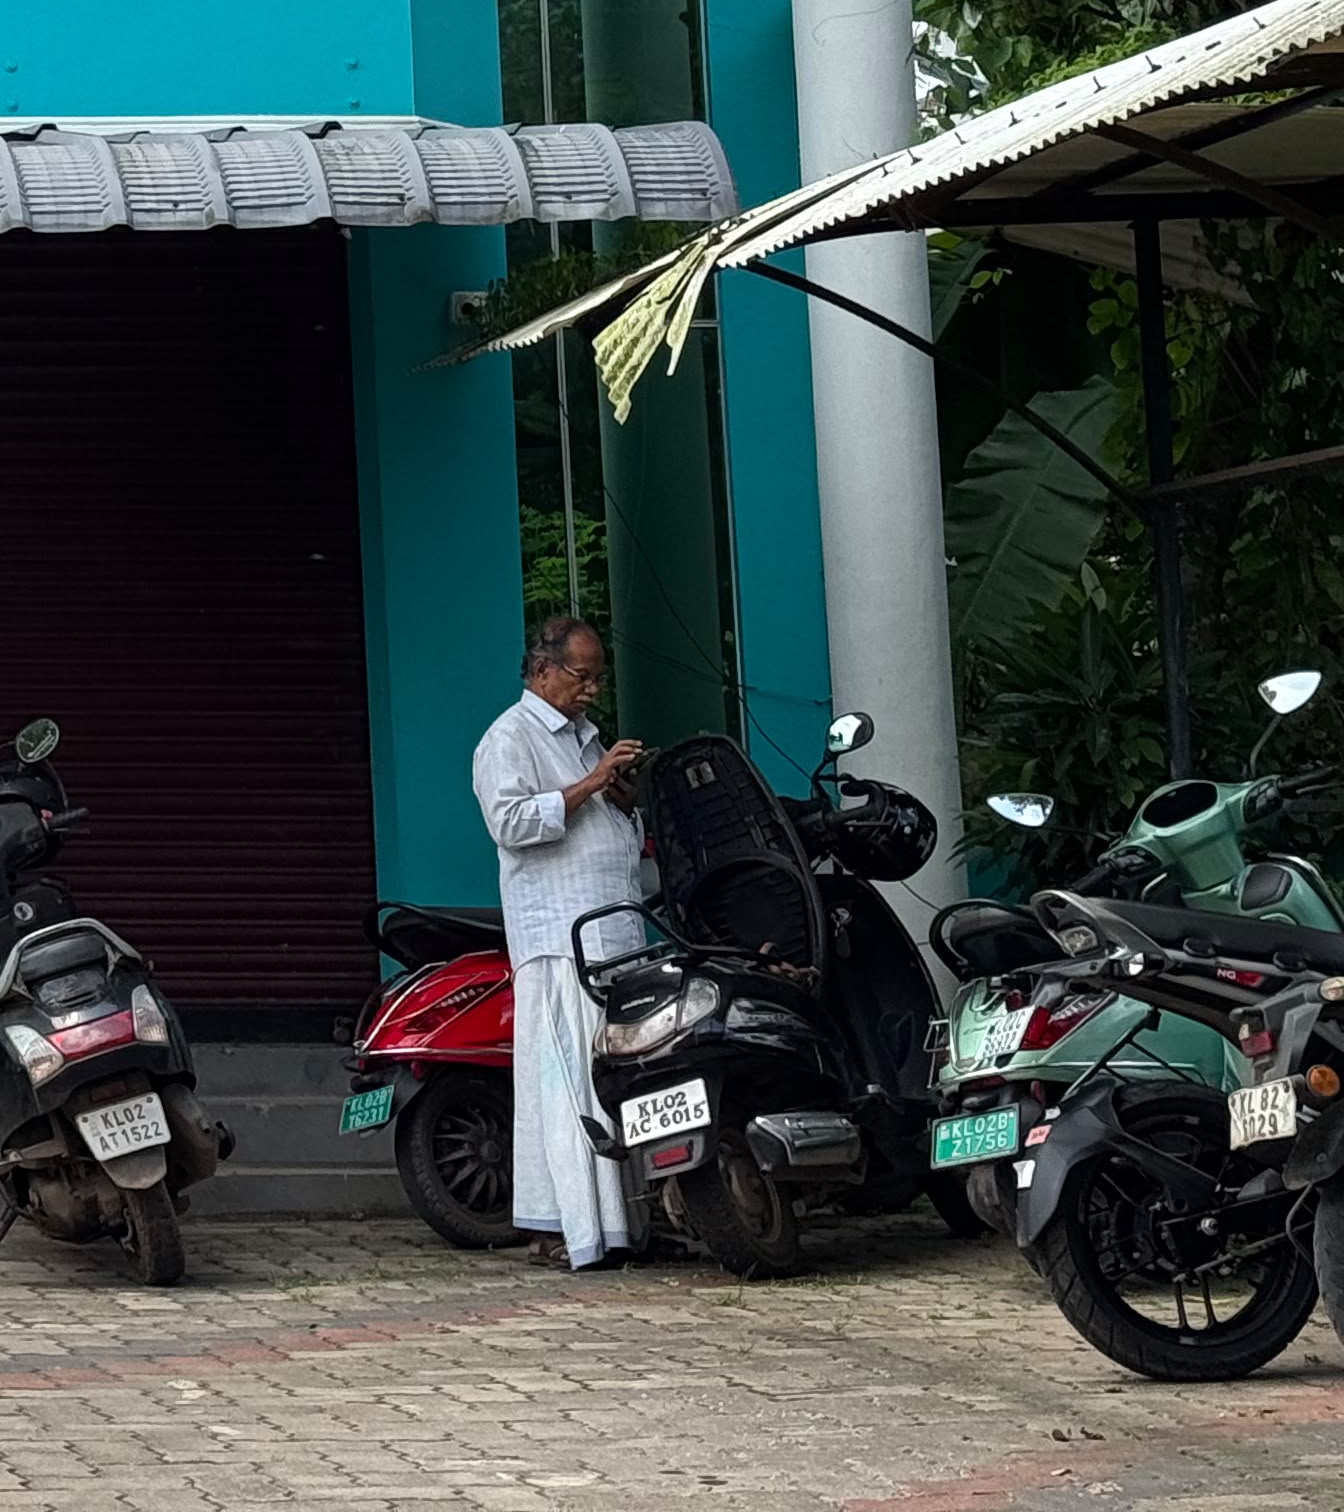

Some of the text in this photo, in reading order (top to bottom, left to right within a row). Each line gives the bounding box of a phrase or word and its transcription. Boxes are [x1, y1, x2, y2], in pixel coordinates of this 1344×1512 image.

[100, 1103, 146, 1130] KL02
[637, 1091, 688, 1119] KL02
[99, 1121, 164, 1153] AT1522
[952, 1113, 1008, 1138] KL02B
[951, 1131, 1008, 1157] Z1756
